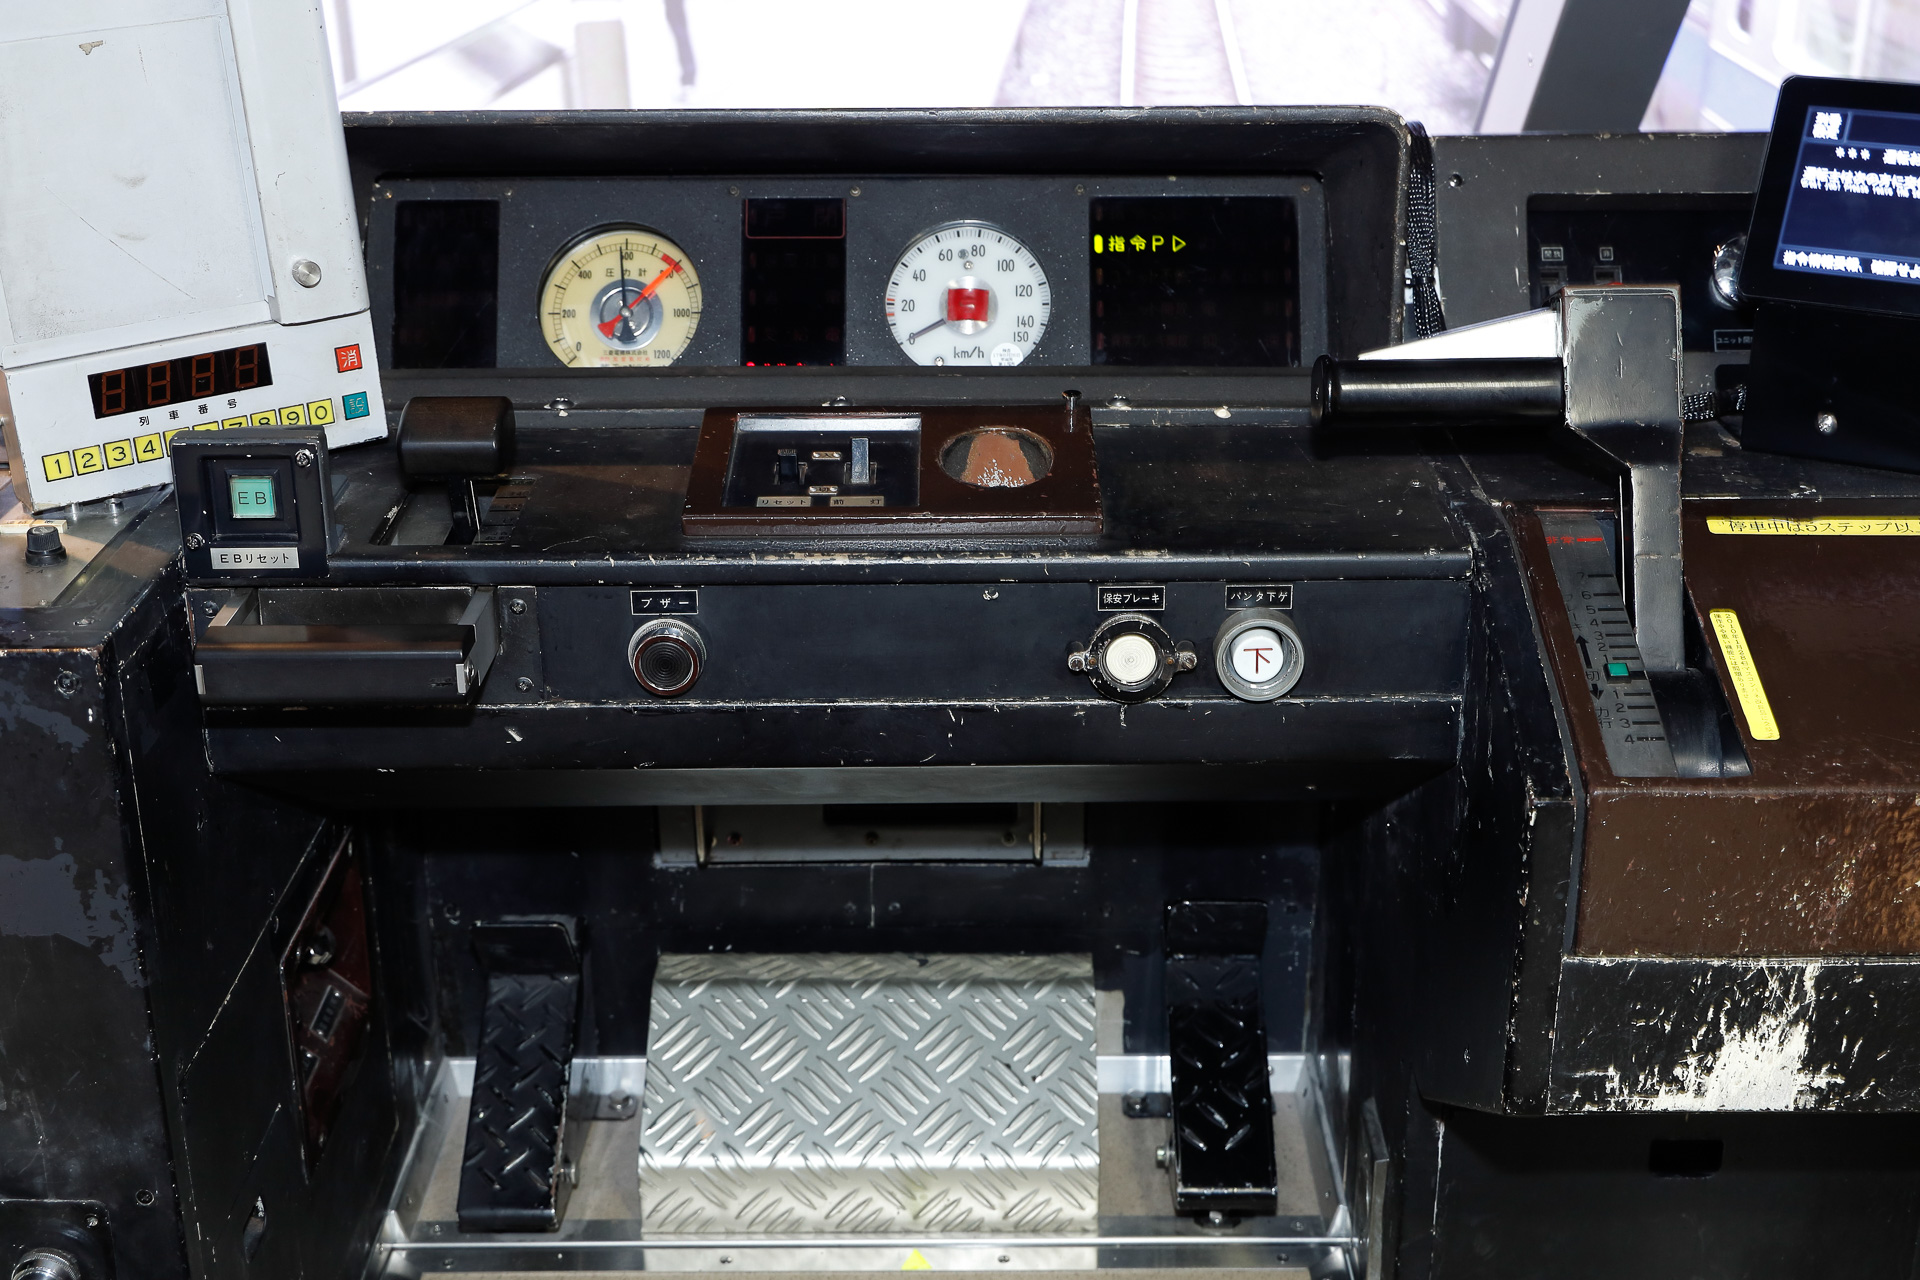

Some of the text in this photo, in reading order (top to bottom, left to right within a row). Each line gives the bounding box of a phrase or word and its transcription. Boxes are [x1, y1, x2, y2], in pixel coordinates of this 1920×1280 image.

[938, 249, 953, 261] 60
[971, 245, 985, 257] 80
[997, 259, 1015, 272] 100
[578, 270, 592, 280] 400
[605, 268, 647, 278] 圧力計
[912, 269, 926, 282] 40
[1015, 285, 1033, 297] 120
[901, 300, 915, 312] 20
[562, 309, 576, 319] 200
[673, 308, 691, 318] 1000
[1016, 315, 1034, 328] 140
[1013, 331, 1029, 342] 150
[576, 341, 582, 352] 0
[653, 349, 671, 359] 1200
[953, 346, 985, 359] km/h
[341, 349, 358, 368] 消
[138, 399, 238, 426] 列車番号
[54, 458, 62, 474] 1
[81, 452, 97, 469] 2
[112, 446, 127, 462] 3
[142, 439, 157, 454] 4
[286, 411, 300, 425] 9
[237, 491, 267, 505] EB
[220, 553, 290, 564] EBリセット
[1103, 593, 1160, 604] 保安ブレーキ
[1230, 591, 1288, 603] パンタ下ゲ
[1581, 591, 1592, 600] 6
[641, 598, 689, 608] ブザー
[1585, 605, 1596, 615] 5
[1589, 618, 1600, 628] 4
[1594, 631, 1604, 641] 3
[1597, 643, 1608, 651] 2
[1243, 648, 1274, 674] 下
[1585, 670, 1600, 681] 切
[1612, 690, 1619, 700] 1
[1615, 702, 1626, 713] 2
[1595, 707, 1613, 729] 力行
[1619, 718, 1631, 729] 3
[1624, 734, 1635, 745] 4
